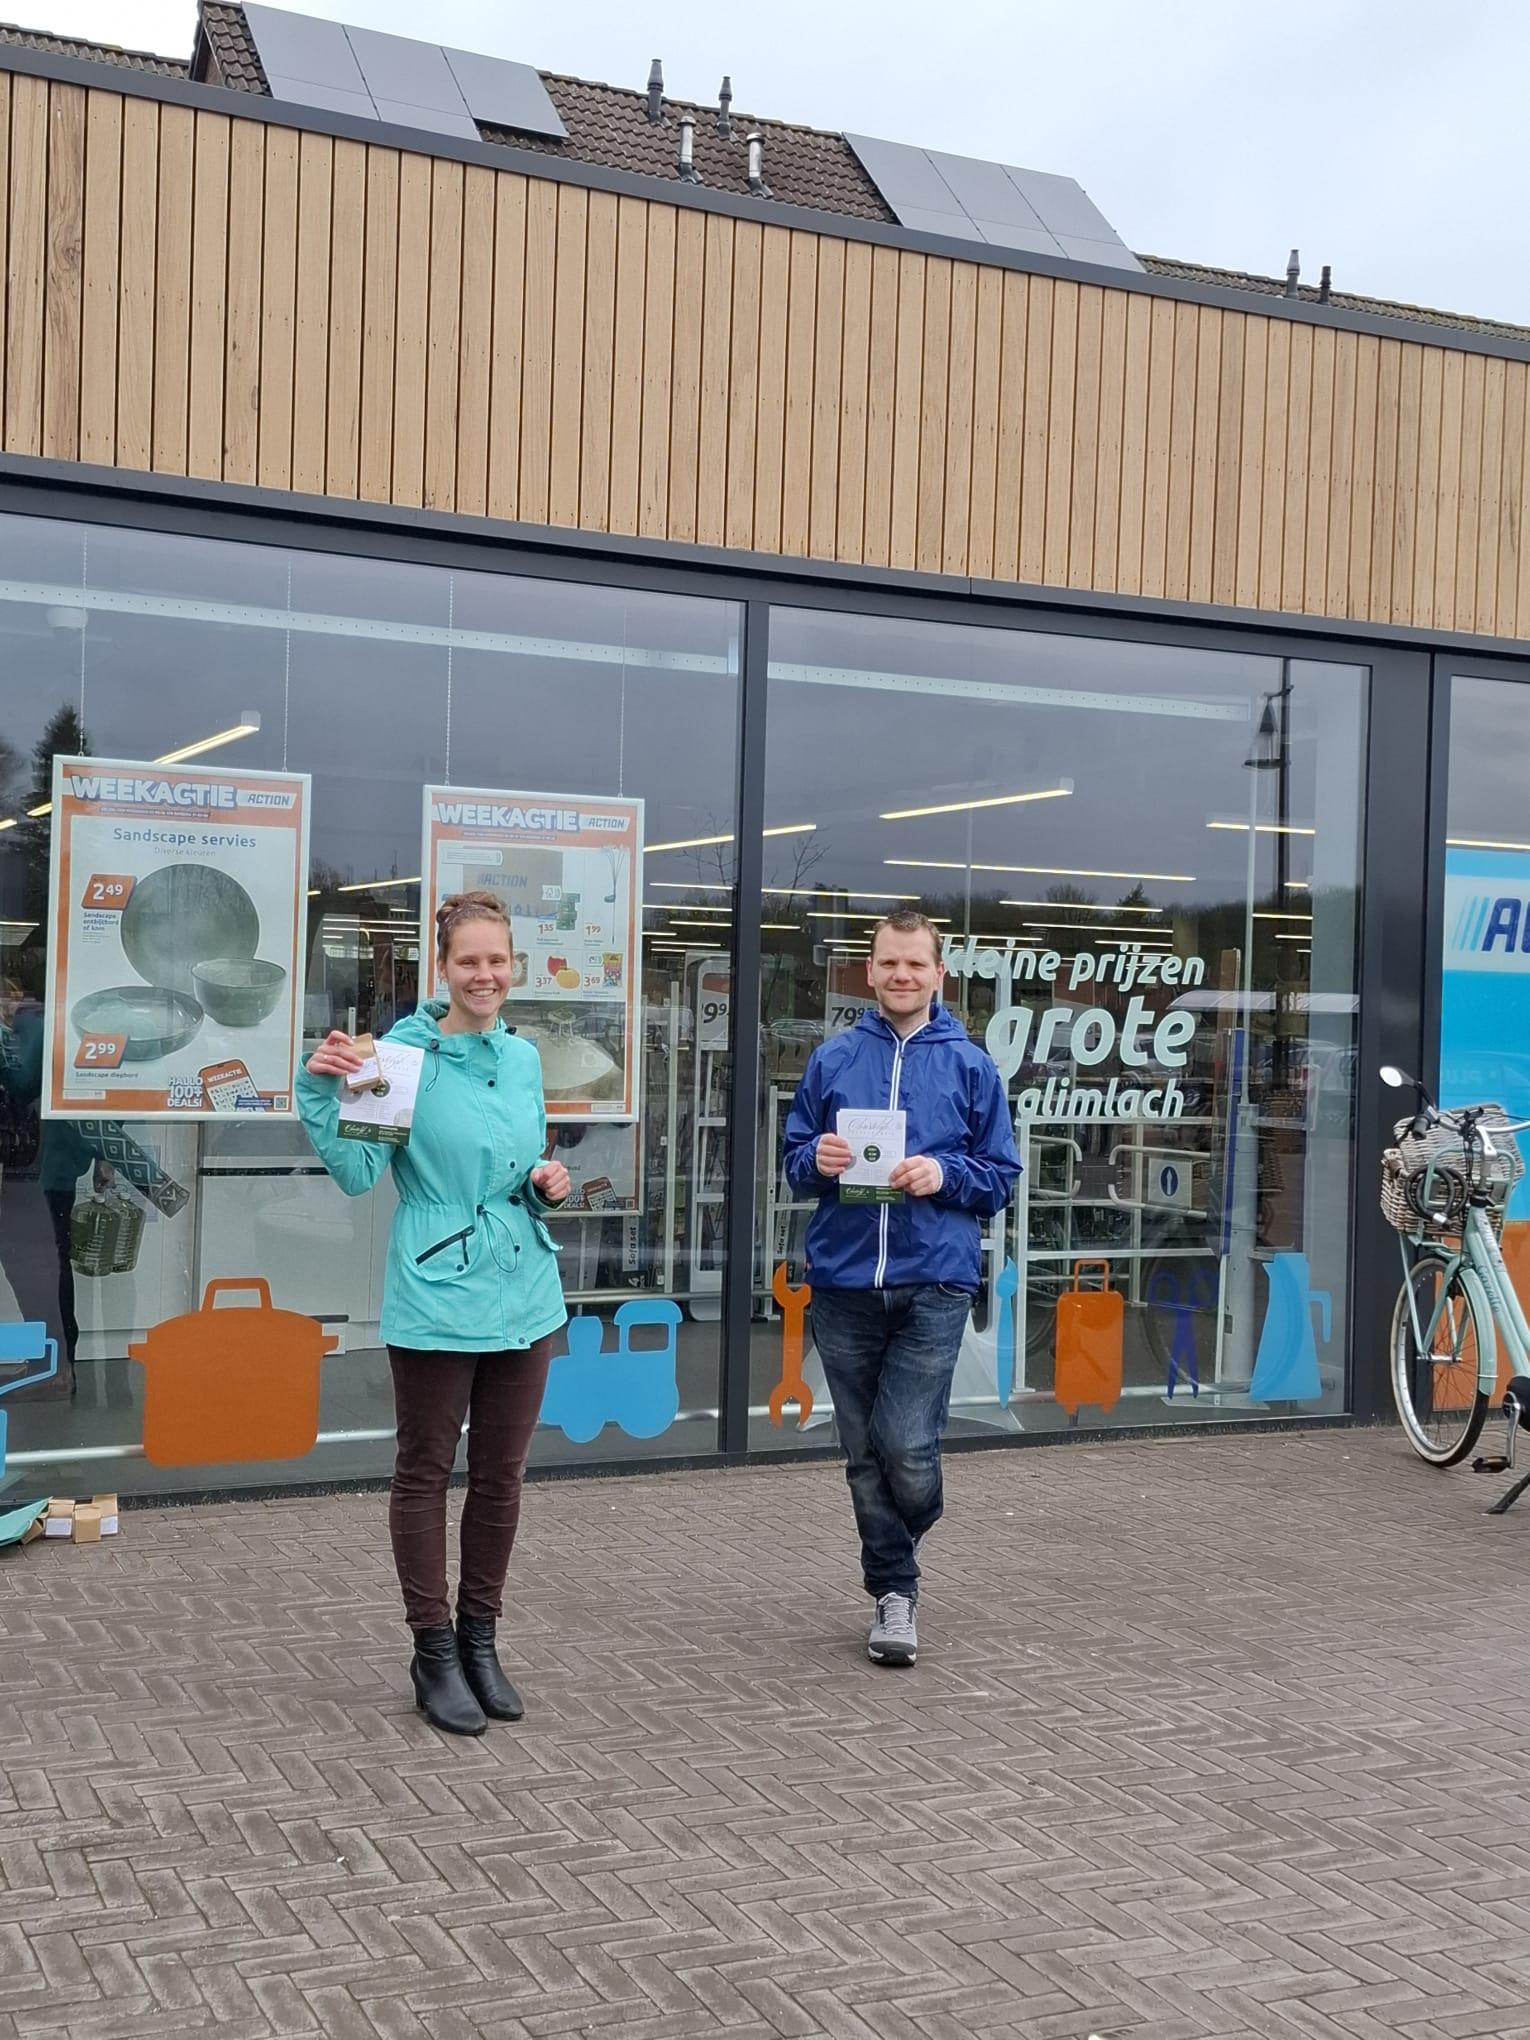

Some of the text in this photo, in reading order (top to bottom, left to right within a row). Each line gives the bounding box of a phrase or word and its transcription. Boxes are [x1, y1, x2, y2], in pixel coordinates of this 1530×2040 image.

[71, 775, 289, 809] WEEKACTIE ACTION
[438, 802, 625, 832] WEEKACTIE ACTION
[113, 828, 257, 848] Sandscape servies
[482, 873, 528, 889] ACTION
[1481, 898, 1530, 953] A
[942, 934, 1205, 992] kleine prijzen
[985, 995, 1196, 1081] grote
[168, 1077, 203, 1086] HALLO
[169, 1085, 203, 1098] 100+
[167, 1098, 203, 1107] DEALS!
